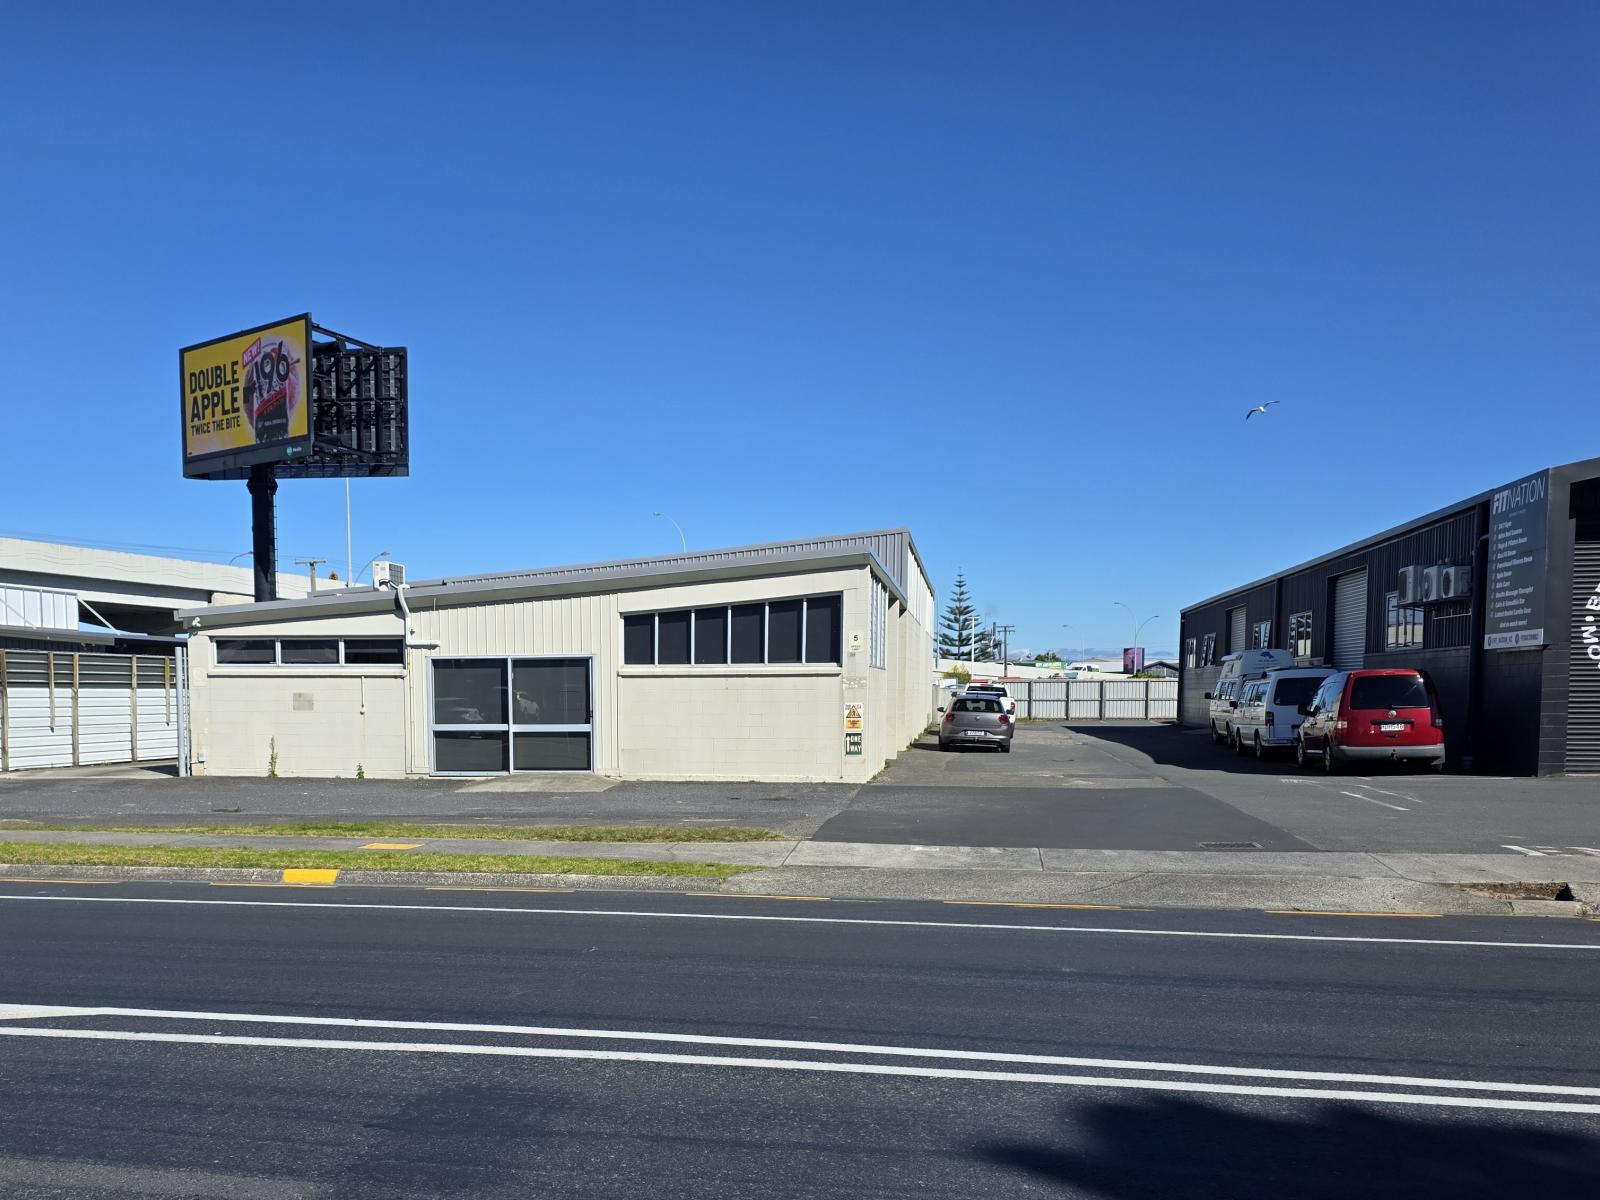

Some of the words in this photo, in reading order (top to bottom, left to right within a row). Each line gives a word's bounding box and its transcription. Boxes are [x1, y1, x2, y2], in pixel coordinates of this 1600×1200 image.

[243, 340, 260, 365] NEW!
[190, 360, 240, 394] DOUBLE
[191, 386, 240, 422] APPLE
[191, 422, 210, 436] TWICE
[212, 418, 224, 432] THE
[226, 416, 240, 430] BITE
